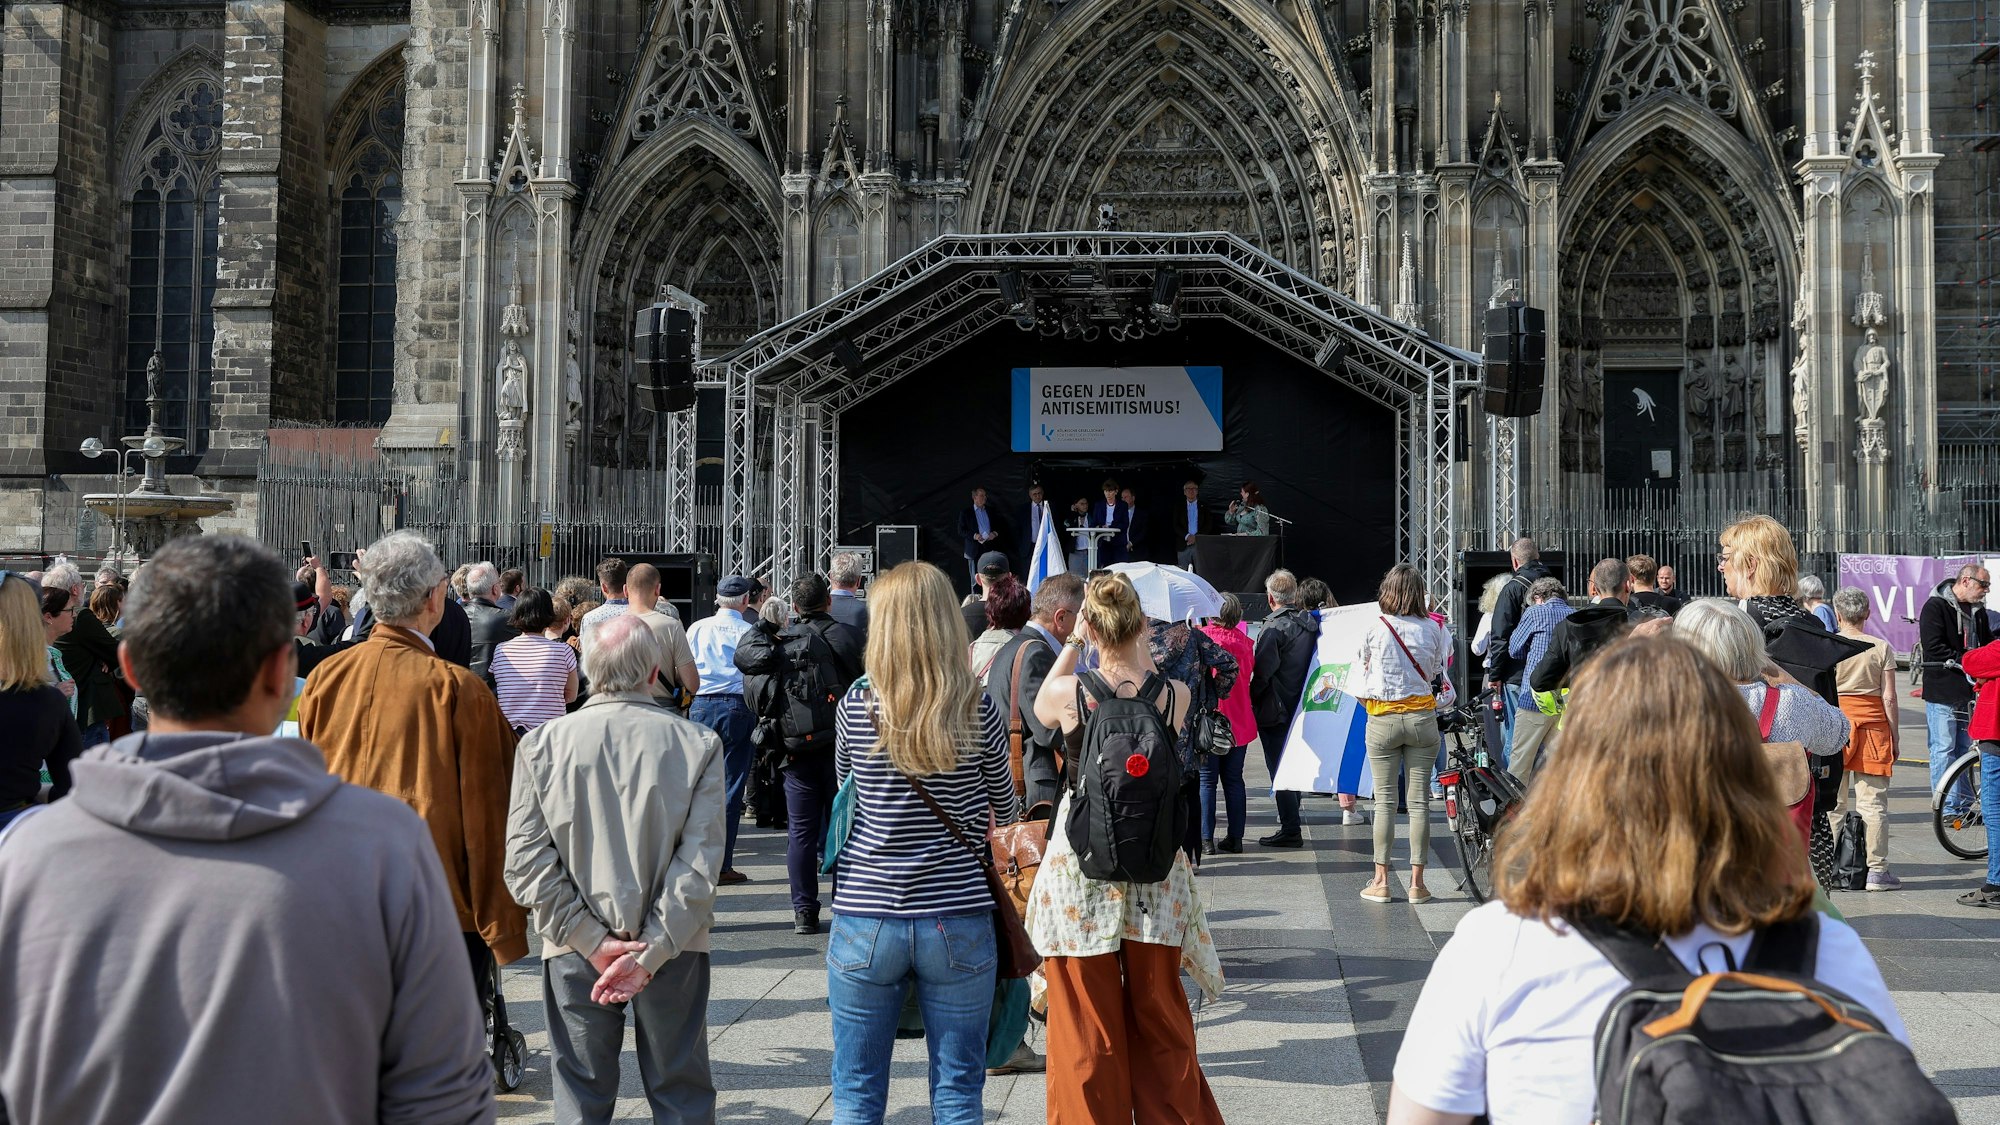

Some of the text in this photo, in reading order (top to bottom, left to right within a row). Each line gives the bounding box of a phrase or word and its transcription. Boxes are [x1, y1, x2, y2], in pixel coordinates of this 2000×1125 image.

[1042, 384, 1145, 398] GEGEN JEDEN
[1041, 400, 1180, 415] ANTISEMITISMUS!
[1840, 554, 1898, 574] Stadt
